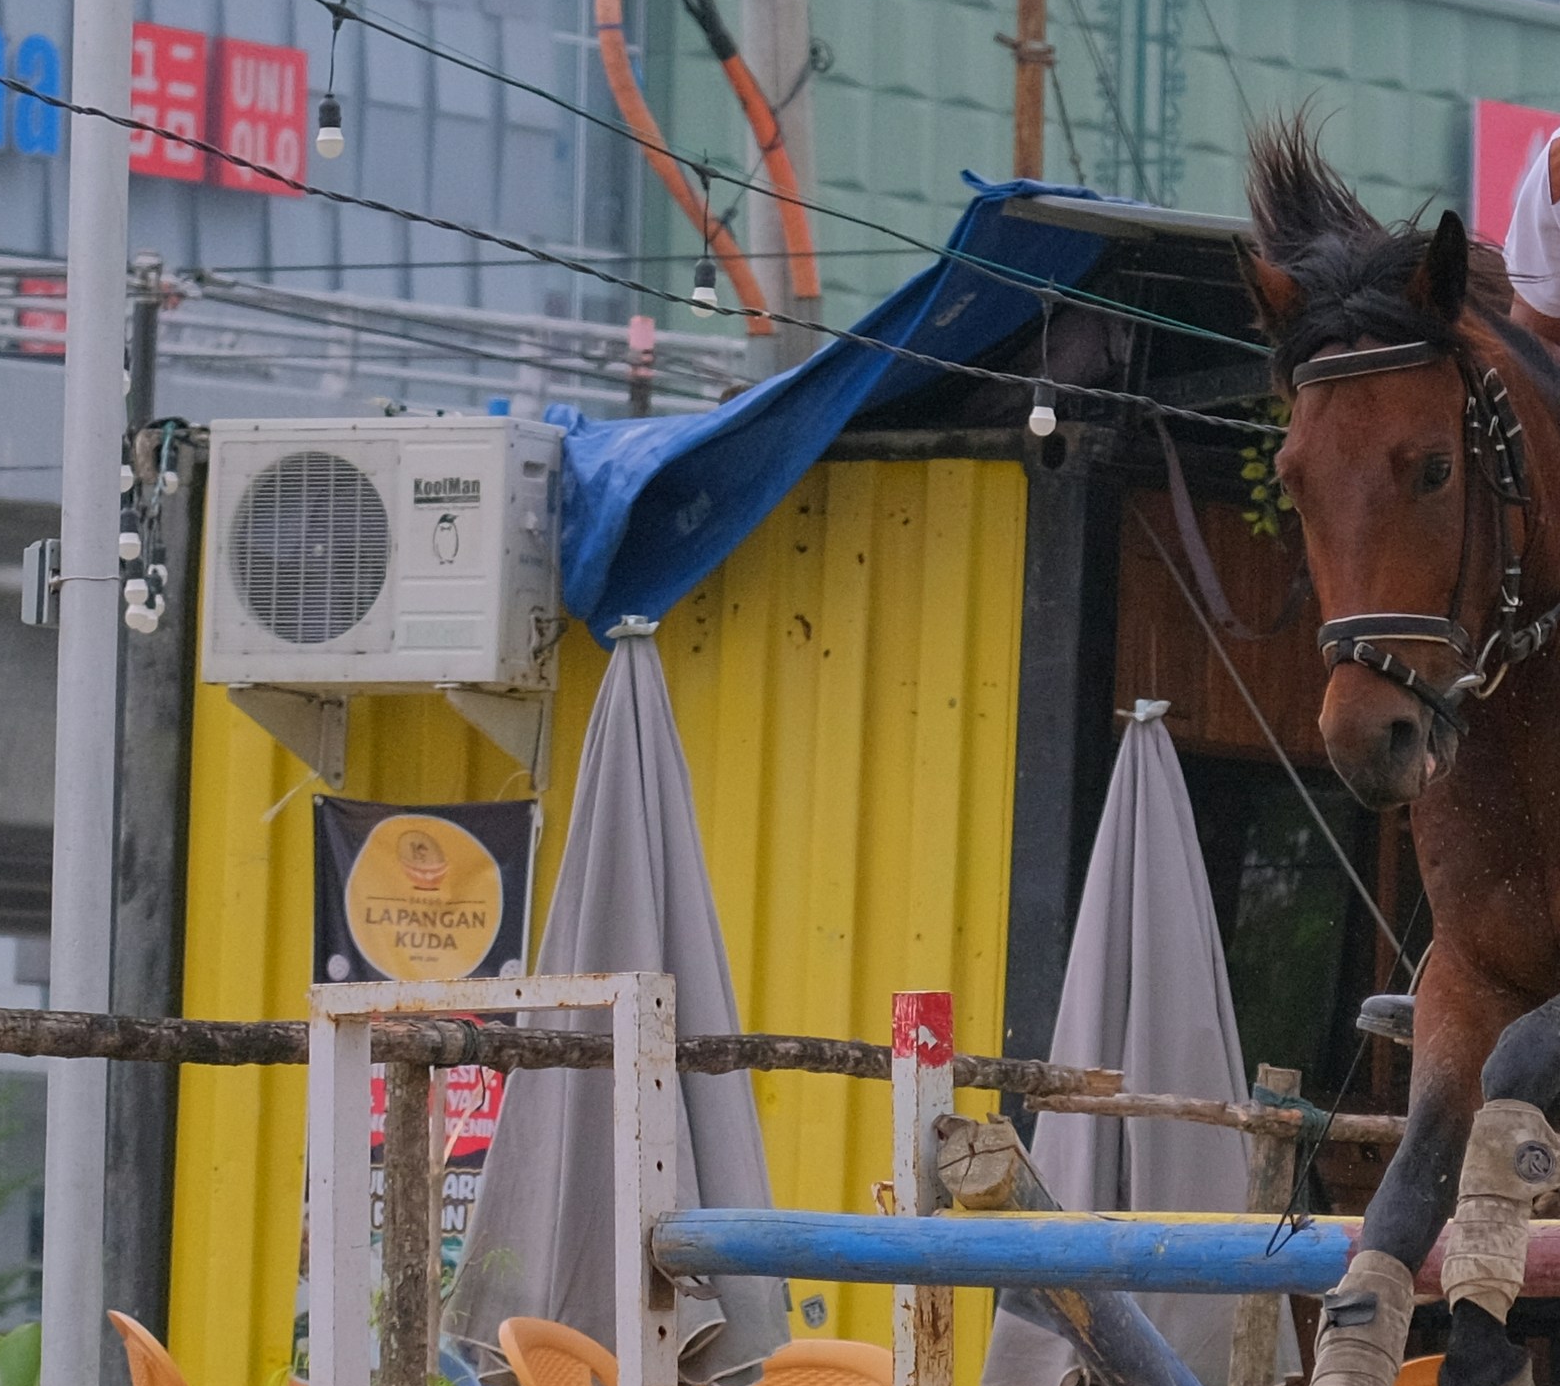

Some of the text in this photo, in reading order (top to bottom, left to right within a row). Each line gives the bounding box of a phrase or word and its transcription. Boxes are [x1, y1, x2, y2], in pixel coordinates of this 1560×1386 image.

[231, 56, 296, 116] UNI
[414, 477, 480, 495] KoolMan
[365, 907, 486, 929] LAPANGAN
[395, 931, 458, 950] KUDA
